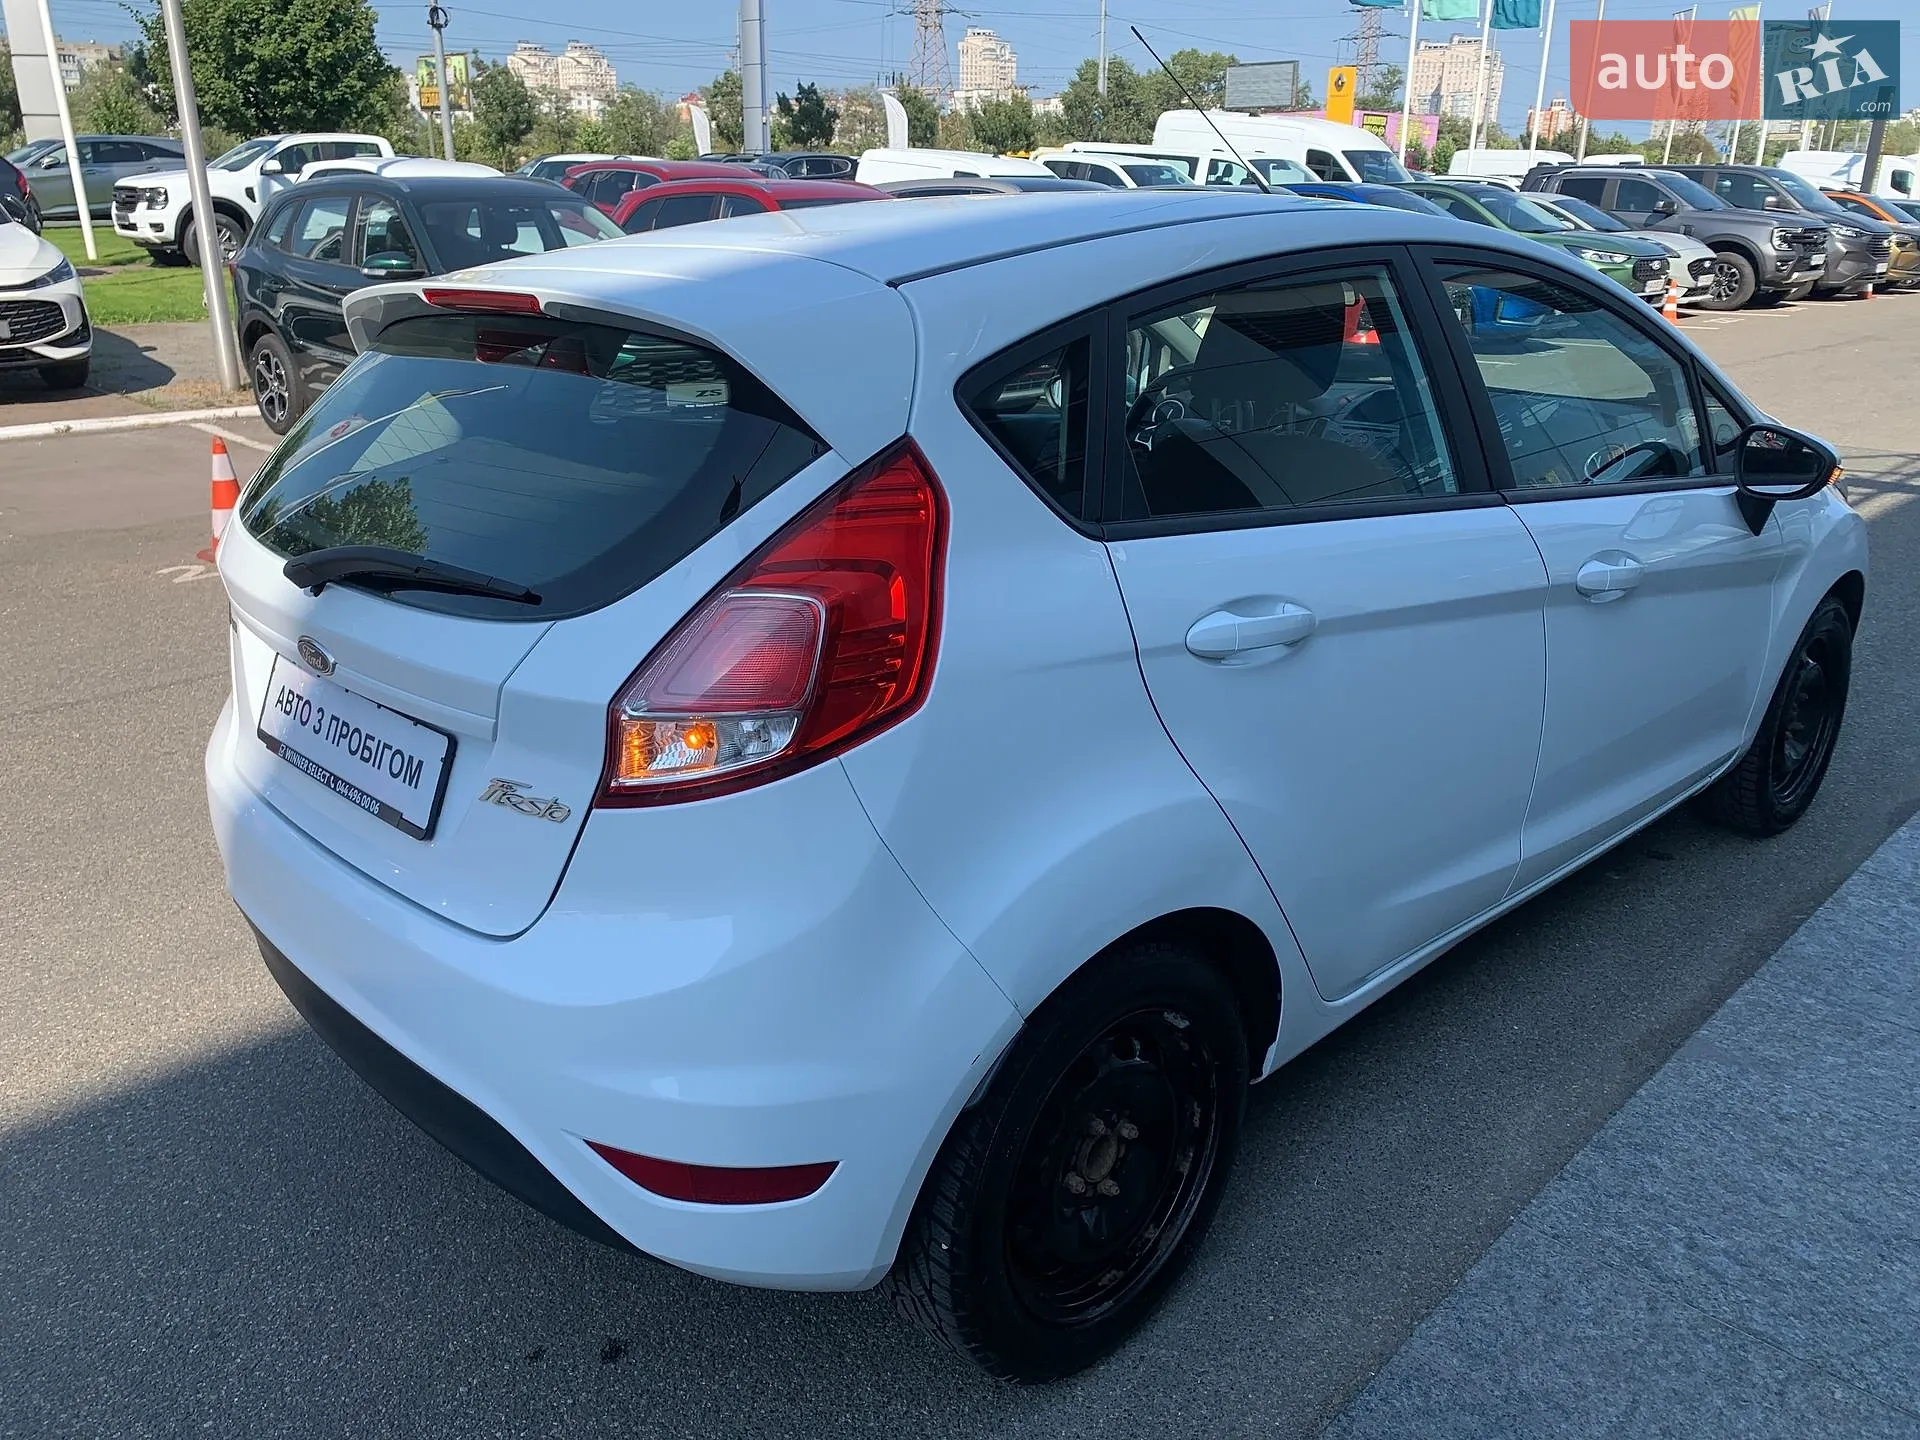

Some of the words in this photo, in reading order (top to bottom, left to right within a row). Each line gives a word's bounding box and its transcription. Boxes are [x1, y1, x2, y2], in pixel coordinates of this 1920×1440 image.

[275, 684, 312, 727] АВТО
[325, 714, 424, 789] ПРОБІГОМ
[286, 747, 309, 772] WINNER
[307, 763, 330, 784] SELECT
[336, 780, 349, 796] 044
[348, 787, 361, 804] 496
[370, 801, 381, 814] 06
[478, 777, 571, 823] Fiesta
